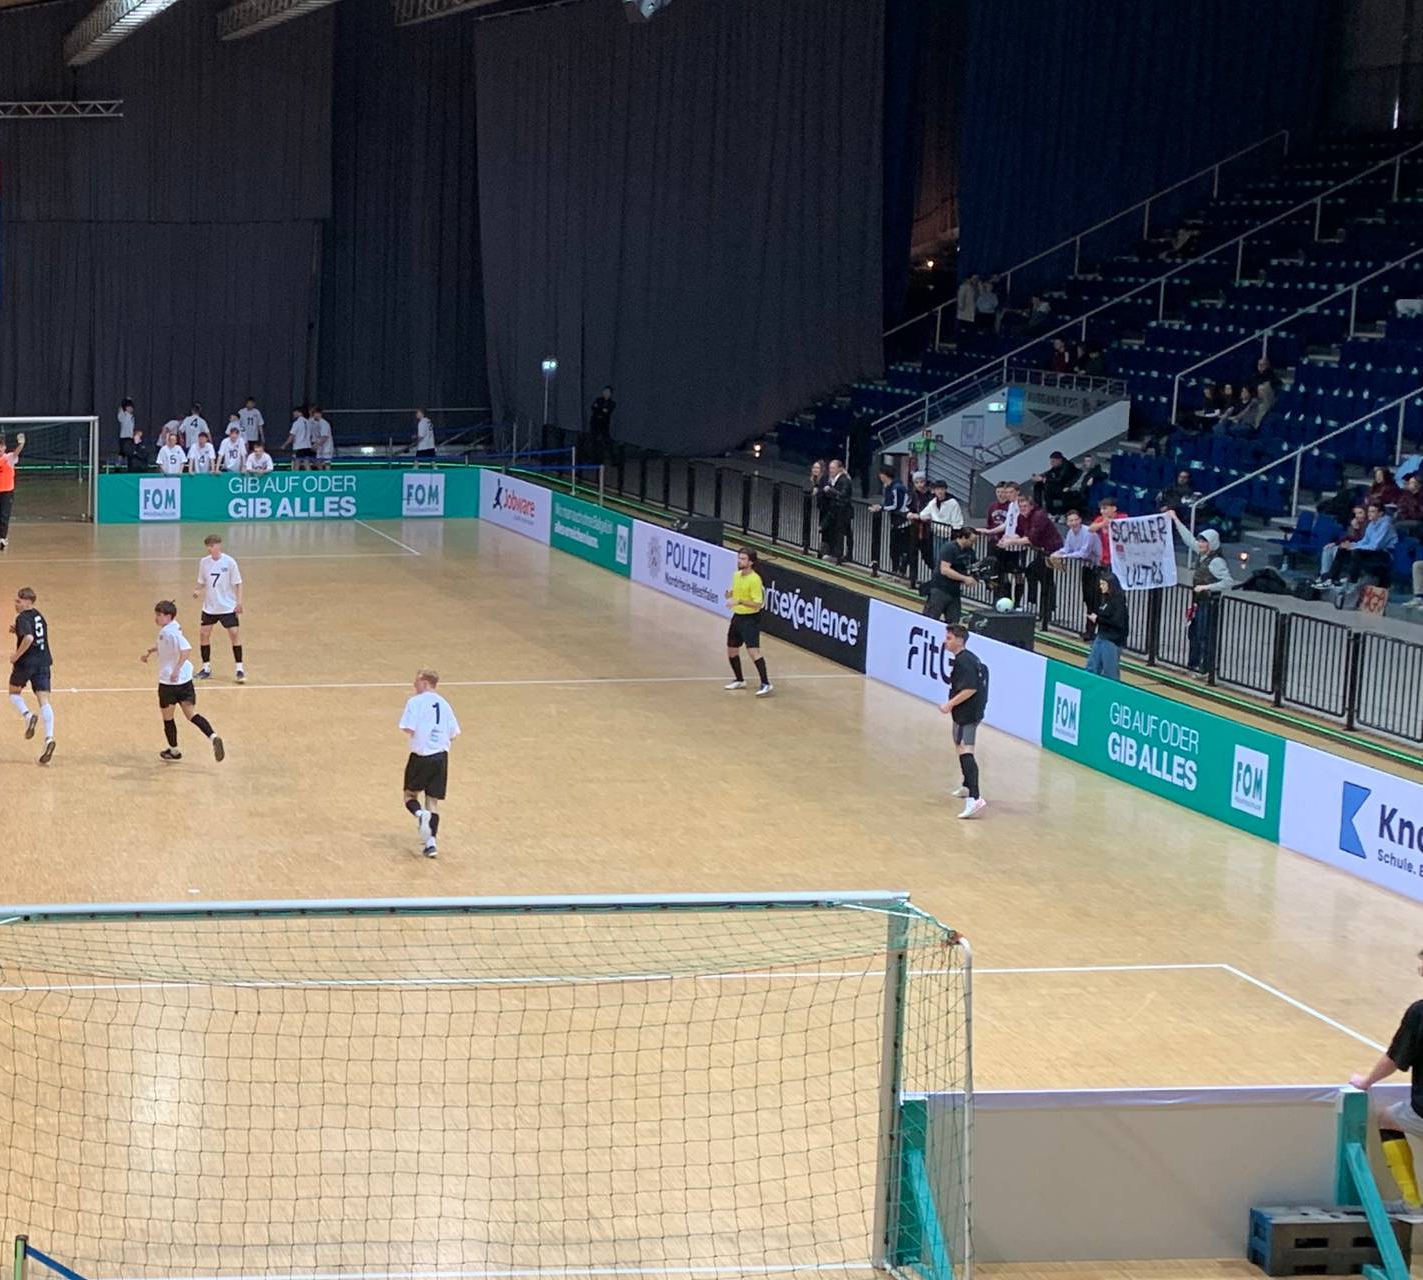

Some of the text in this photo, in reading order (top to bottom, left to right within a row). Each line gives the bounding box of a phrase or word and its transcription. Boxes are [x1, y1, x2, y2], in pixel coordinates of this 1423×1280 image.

[190, 418, 198, 428] 4
[228, 475, 356, 494] GIB AUF ODER
[406, 484, 439, 506] FOM
[143, 488, 176, 510] FOM
[228, 497, 357, 518] GIB ALLES
[665, 540, 711, 581] POLIZEI
[210, 572, 221, 588] 7
[432, 702, 441, 725] 1
[1055, 696, 1077, 731] FOM
[1109, 702, 1199, 754] GIB AUF ODER
[1108, 731, 1198, 791] GIB ALLES
[1235, 761, 1263, 801] FOM
[1377, 848, 1417, 875] Schule.
